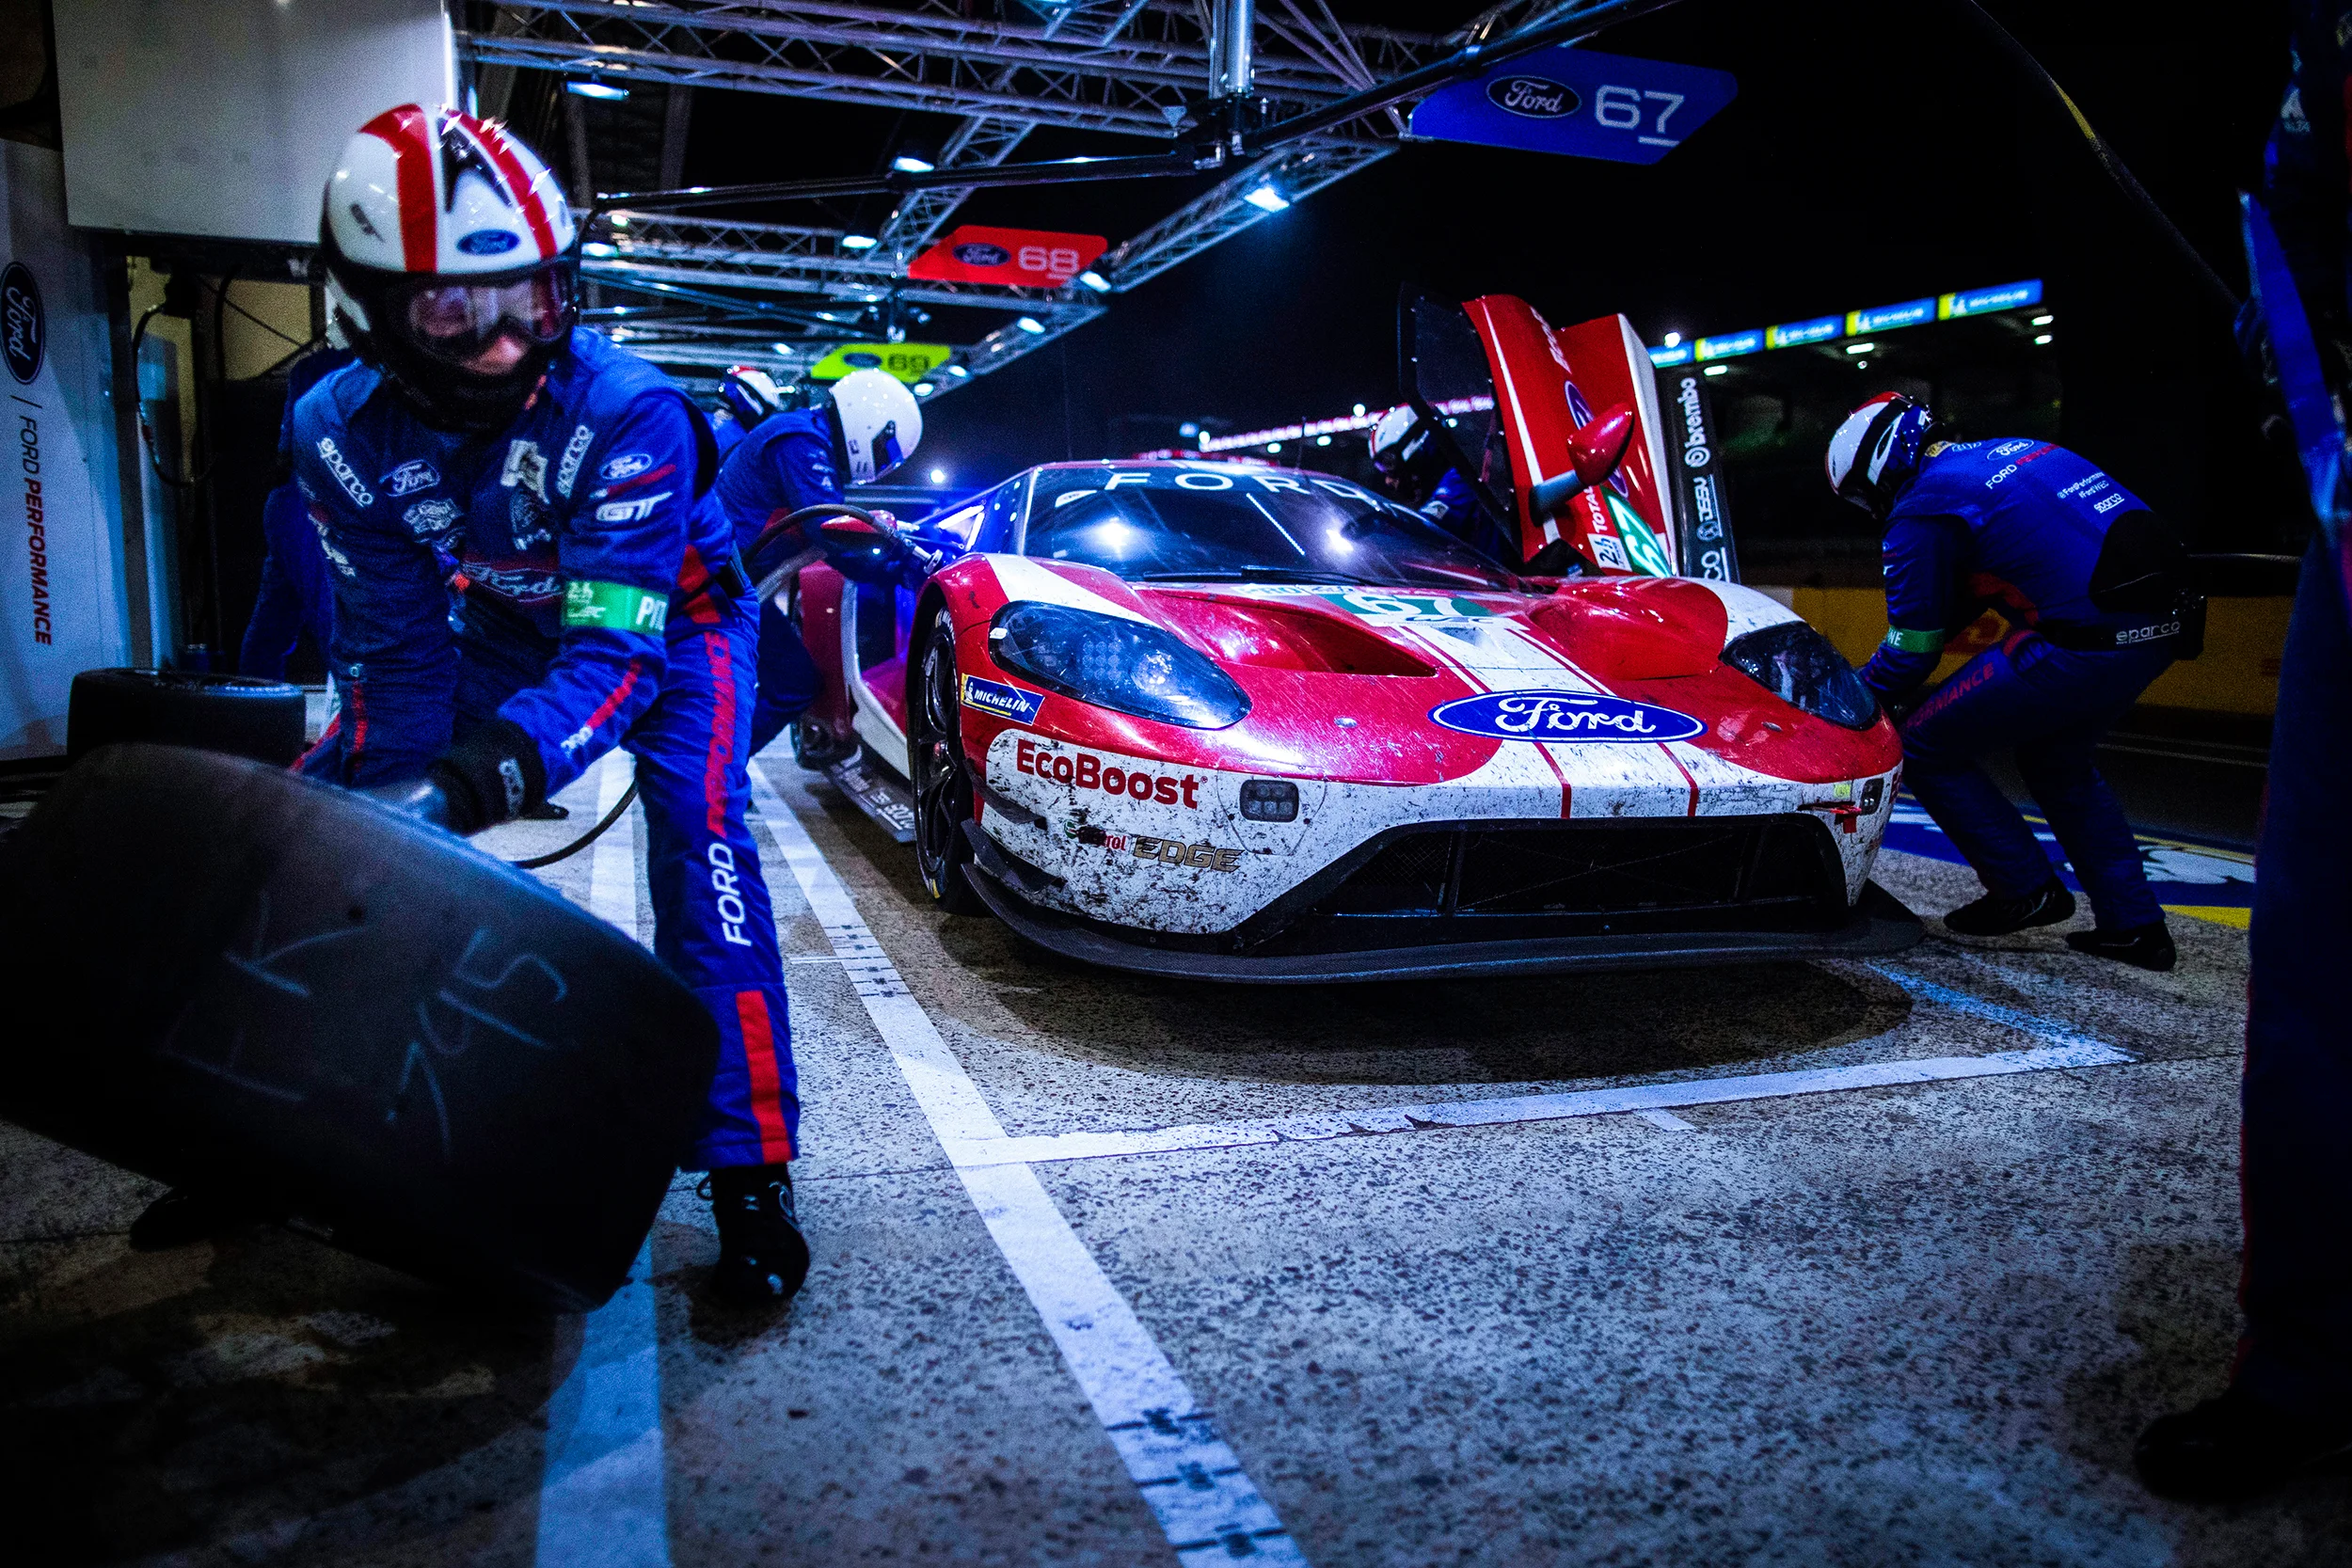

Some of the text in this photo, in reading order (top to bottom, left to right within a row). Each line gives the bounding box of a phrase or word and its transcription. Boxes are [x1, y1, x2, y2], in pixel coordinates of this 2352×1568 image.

[1505, 79, 1685, 134] Ford 67
[1018, 245, 1079, 274] 68
[6, 284, 38, 363] Ford
[1677, 377, 1707, 449] brembo
[316, 437, 373, 508] sparco
[1104, 472, 1387, 511] FORD
[1985, 464, 2019, 490] FORD
[596, 491, 674, 522] GT
[1583, 485, 1608, 533] TOTAL
[20, 415, 53, 646] FORD PERFORMANCE
[1608, 495, 1671, 579] 67
[1343, 590, 1465, 619] 67
[2116, 621, 2181, 644] sparco
[973, 688, 1031, 714] MICHELIN
[1495, 696, 1658, 735] Ford
[1016, 737, 1202, 810] EcoBoost
[1133, 835, 1244, 873] EDGE
[708, 842, 753, 947] FORD
